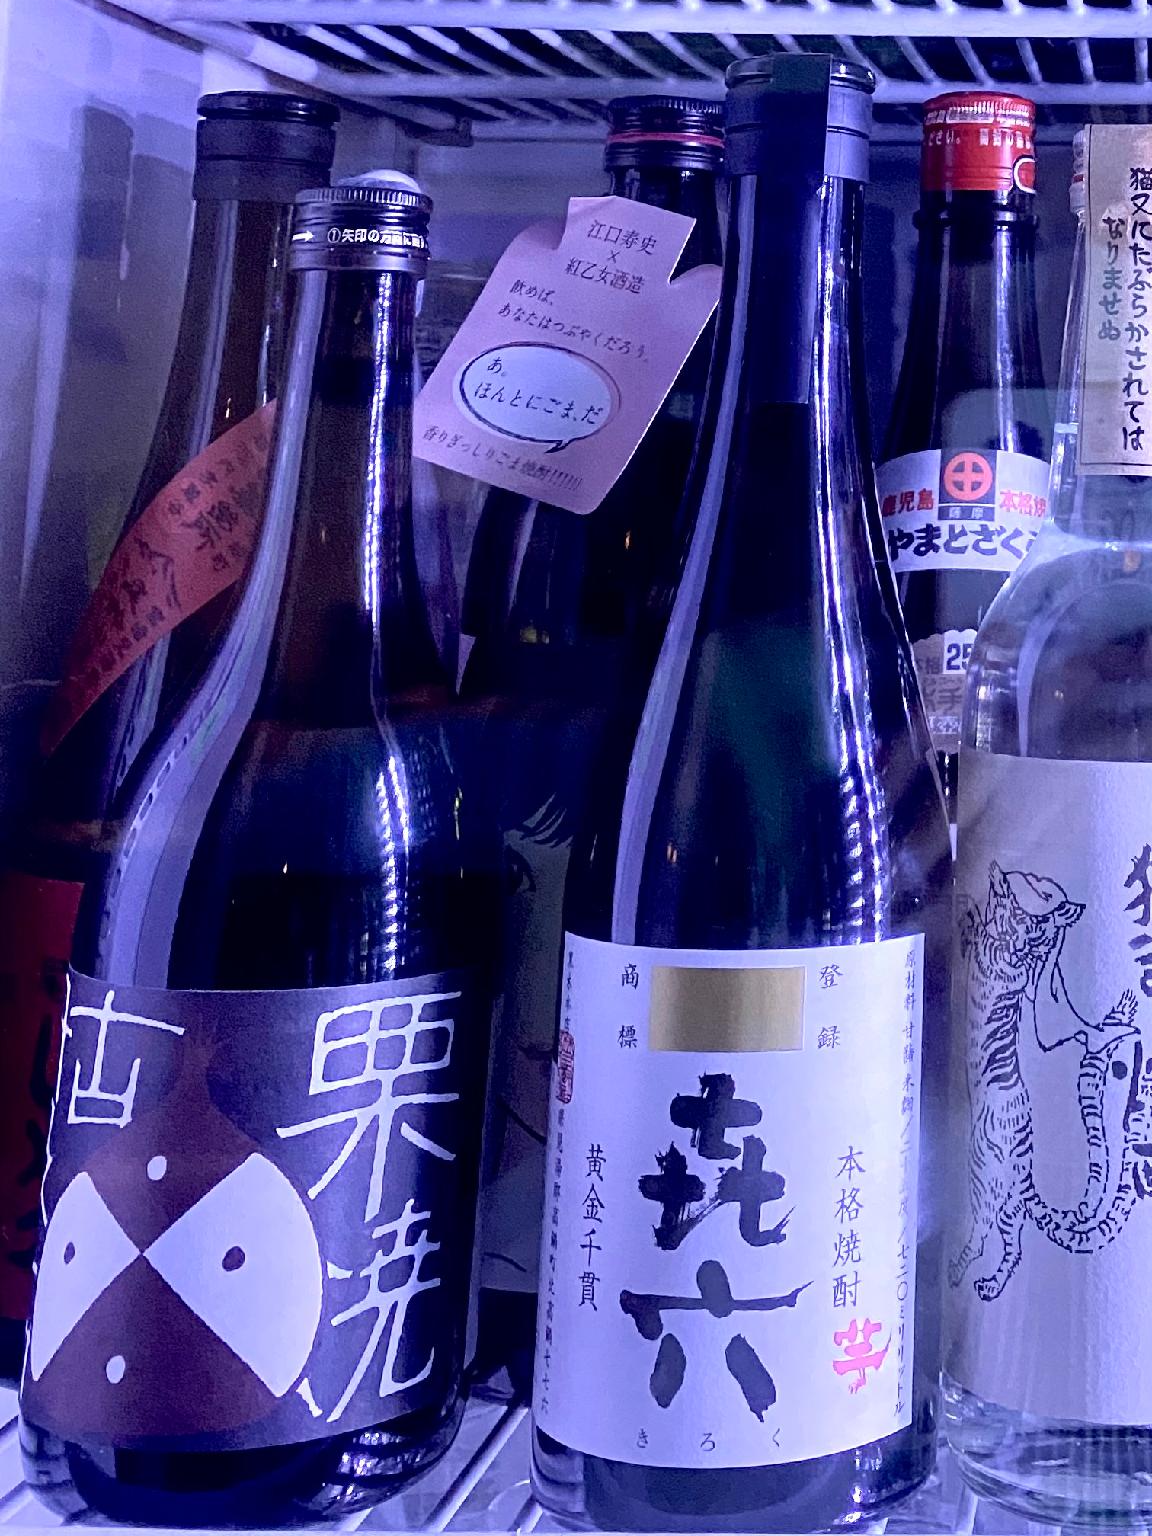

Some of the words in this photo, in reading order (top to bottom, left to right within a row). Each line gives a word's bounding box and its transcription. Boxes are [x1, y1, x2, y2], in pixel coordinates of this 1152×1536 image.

[564, 256, 647, 296] 紅乙女酒造
[586, 218, 658, 256] 江口寿史
[1098, 216, 1126, 341] なりませぬ
[882, 488, 935, 518] 鹿児島
[617, 962, 640, 1050] 商標
[816, 962, 844, 1049] 登録
[577, 1143, 608, 1313] 黄金千貫
[831, 1144, 867, 1309] 本格焼酎
[832, 1317, 893, 1395] 芋
[635, 1426, 783, 1453] きろく
